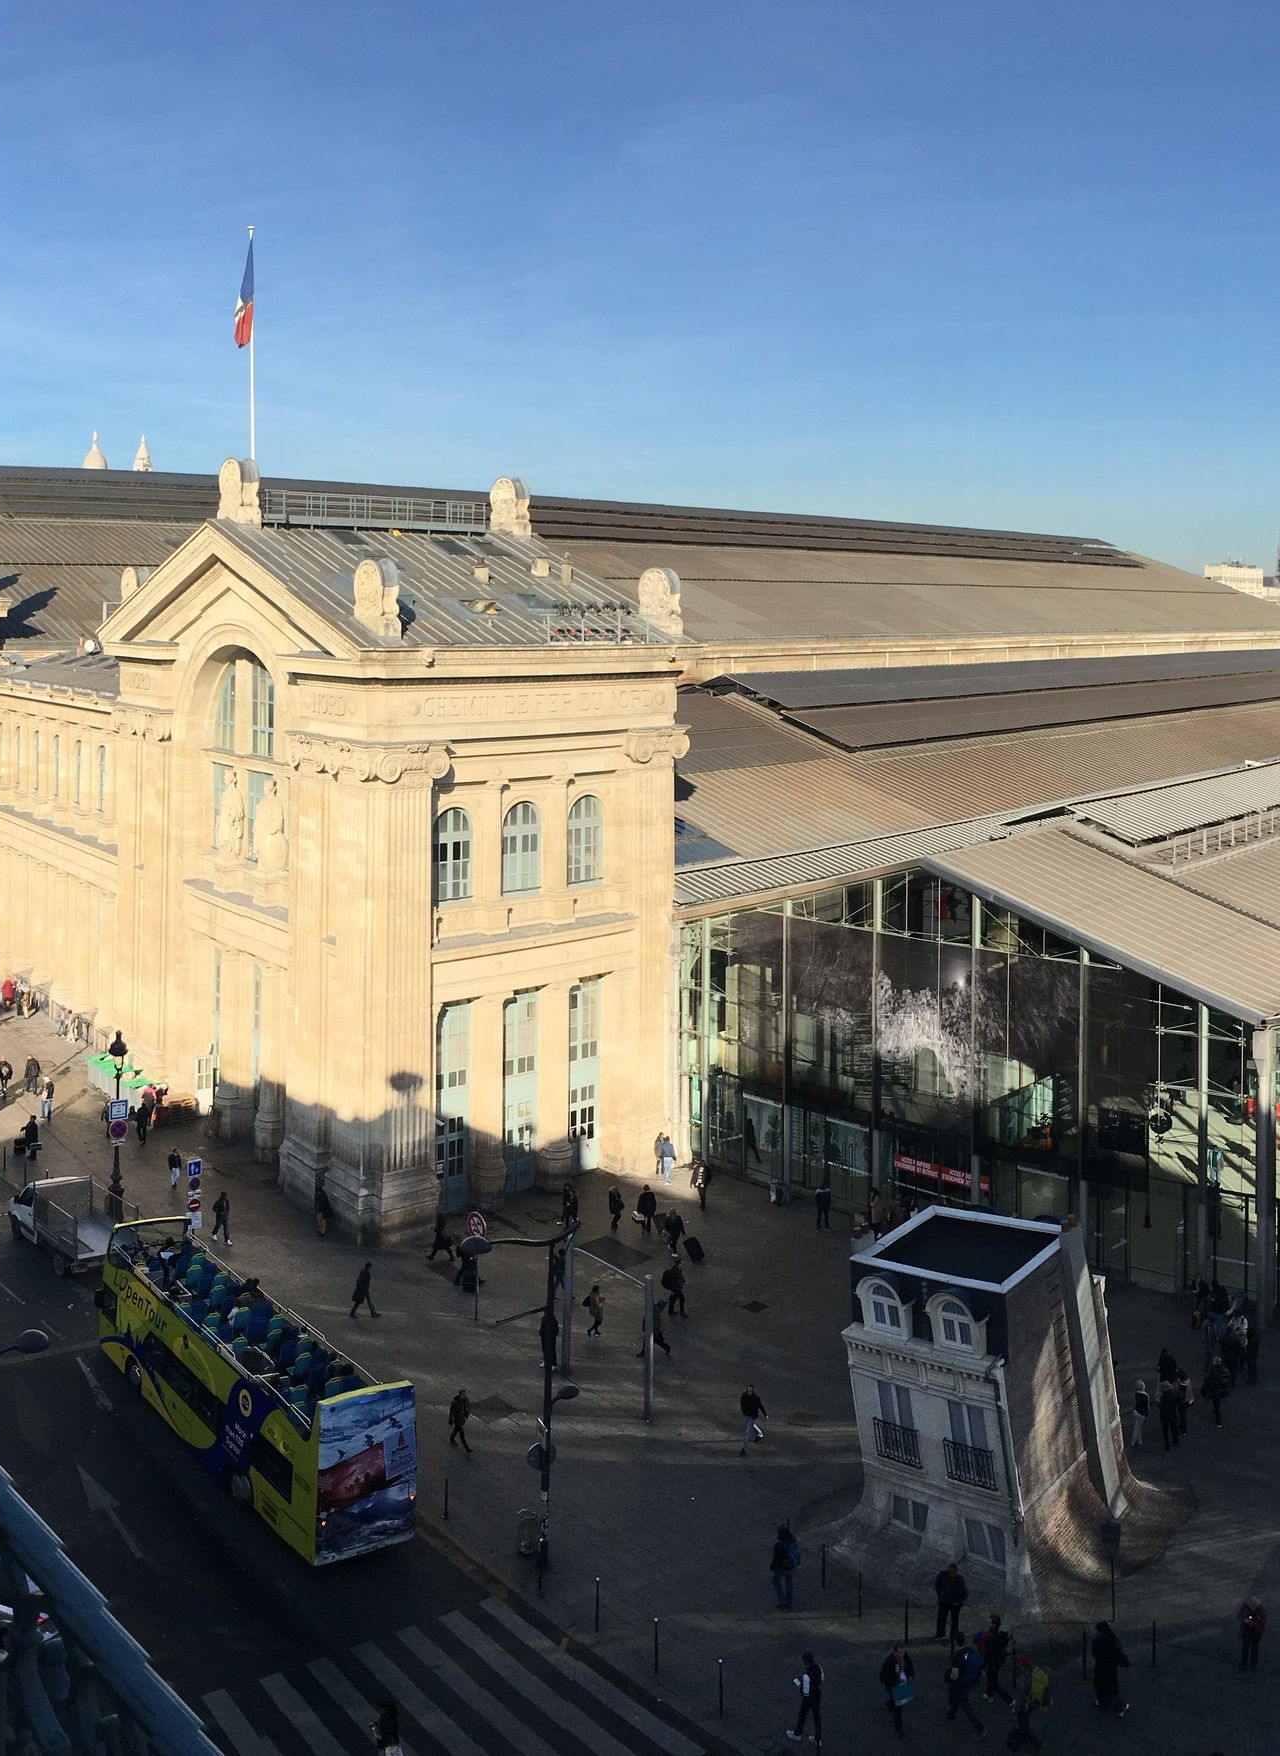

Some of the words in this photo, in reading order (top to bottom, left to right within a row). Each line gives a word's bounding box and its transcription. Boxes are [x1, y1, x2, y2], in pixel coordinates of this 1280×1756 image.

[312, 693, 346, 717] NORD
[423, 695, 496, 718] CHEMIN
[504, 694, 529, 715] DE
[535, 693, 571, 713] FER
[579, 691, 603, 711] DU
[610, 690, 652, 709] NORD
[234, 1421, 246, 1439] More
